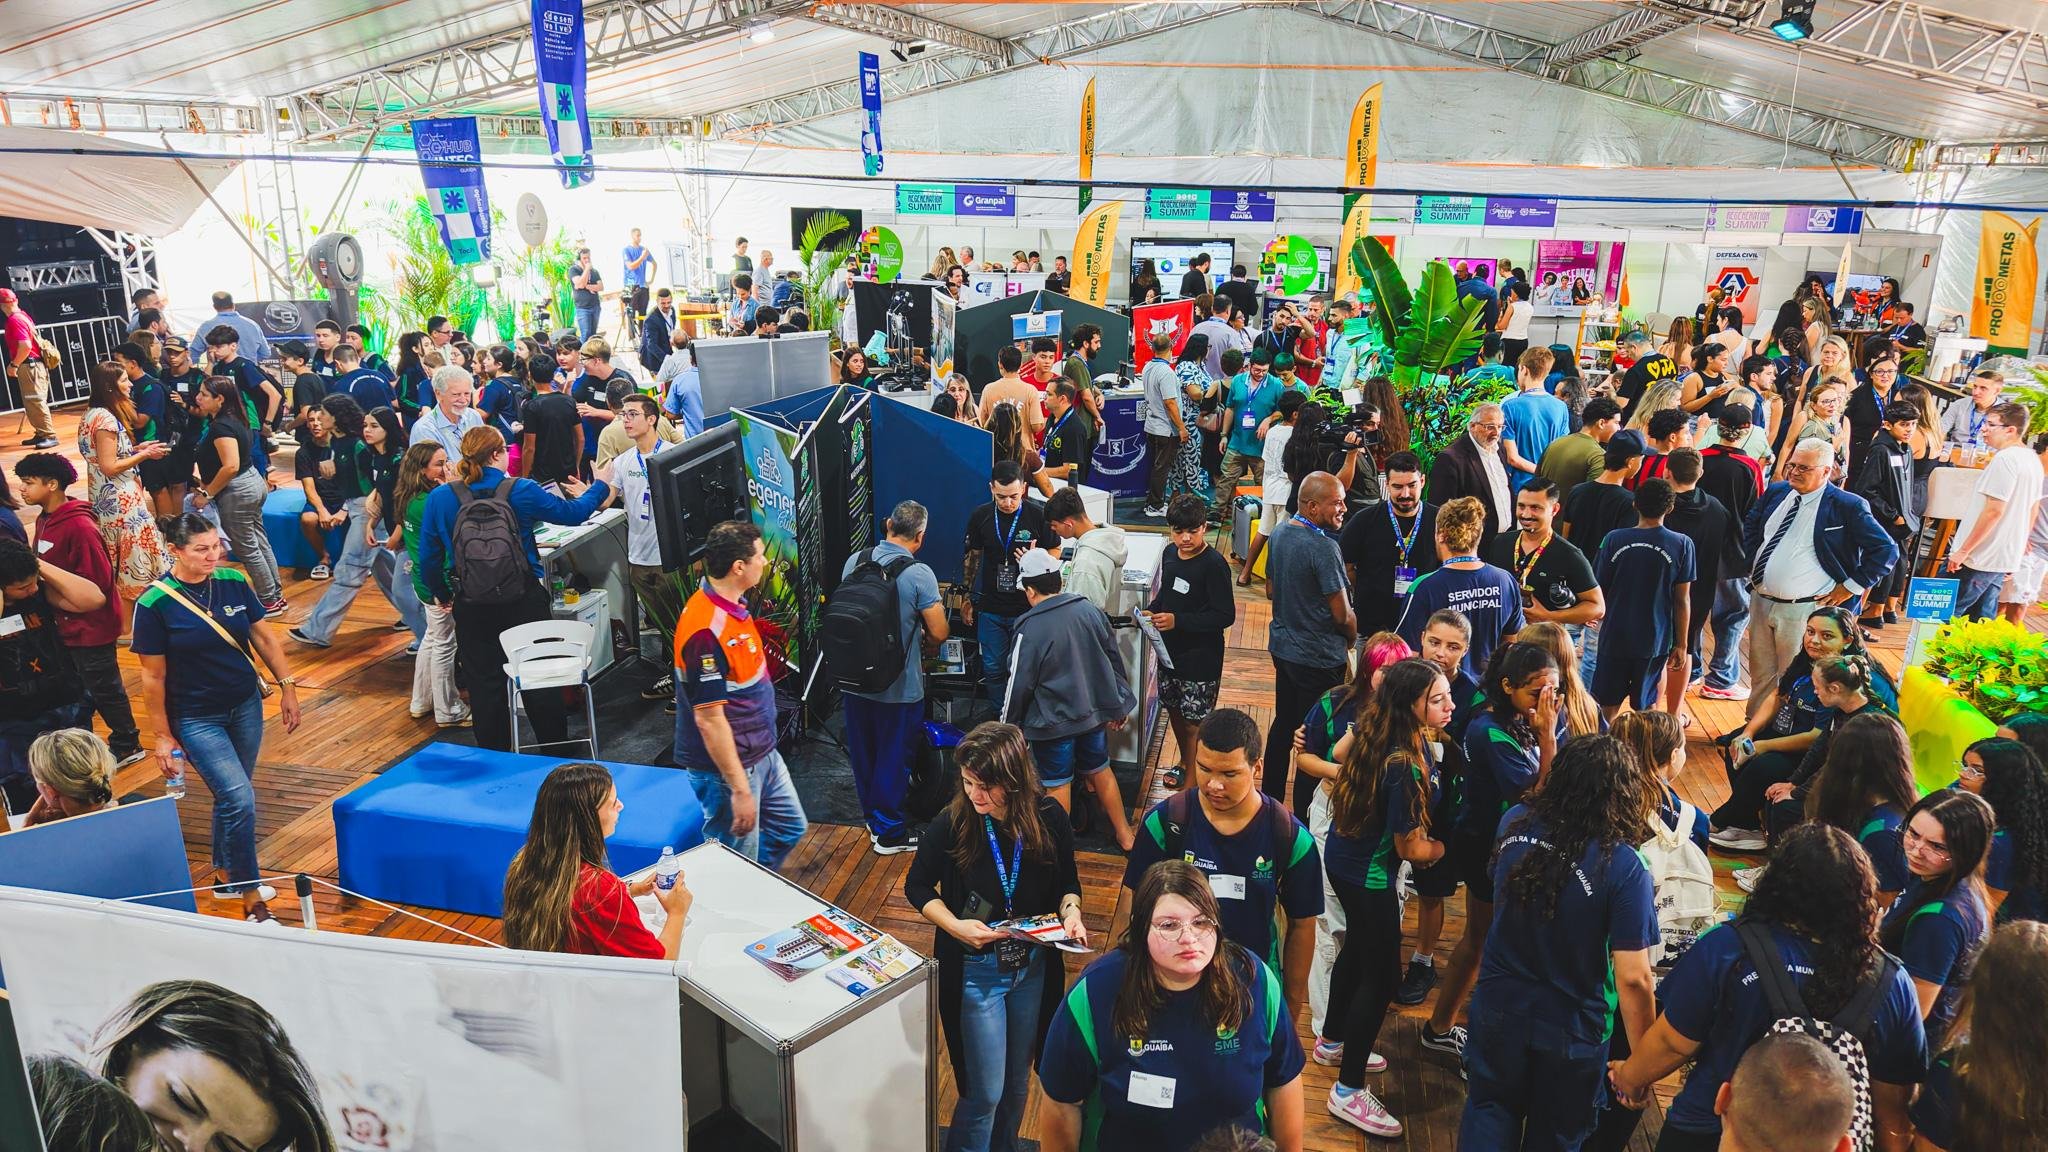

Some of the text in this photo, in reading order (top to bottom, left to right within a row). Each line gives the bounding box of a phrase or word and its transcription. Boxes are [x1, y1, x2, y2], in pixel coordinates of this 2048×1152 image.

[444, 140, 473, 153] HUB
[975, 196, 1006, 206] Granpal
[907, 203, 943, 211] SUMMIT
[1159, 208, 1197, 216] SUMMIT
[1429, 212, 1471, 221] SUMMIT
[1724, 220, 1769, 229] SUMMIT
[1448, 586, 1501, 602] SERVIDOR
[1912, 600, 1951, 609] SUMMIT
[1193, 860, 1218, 871] GUAÍBA
[1251, 870, 1273, 879] SME
[1575, 869, 1594, 897] GUAÍBA
[1144, 1043, 1174, 1052] GUAÍBA
[1214, 1038, 1241, 1051] SME
